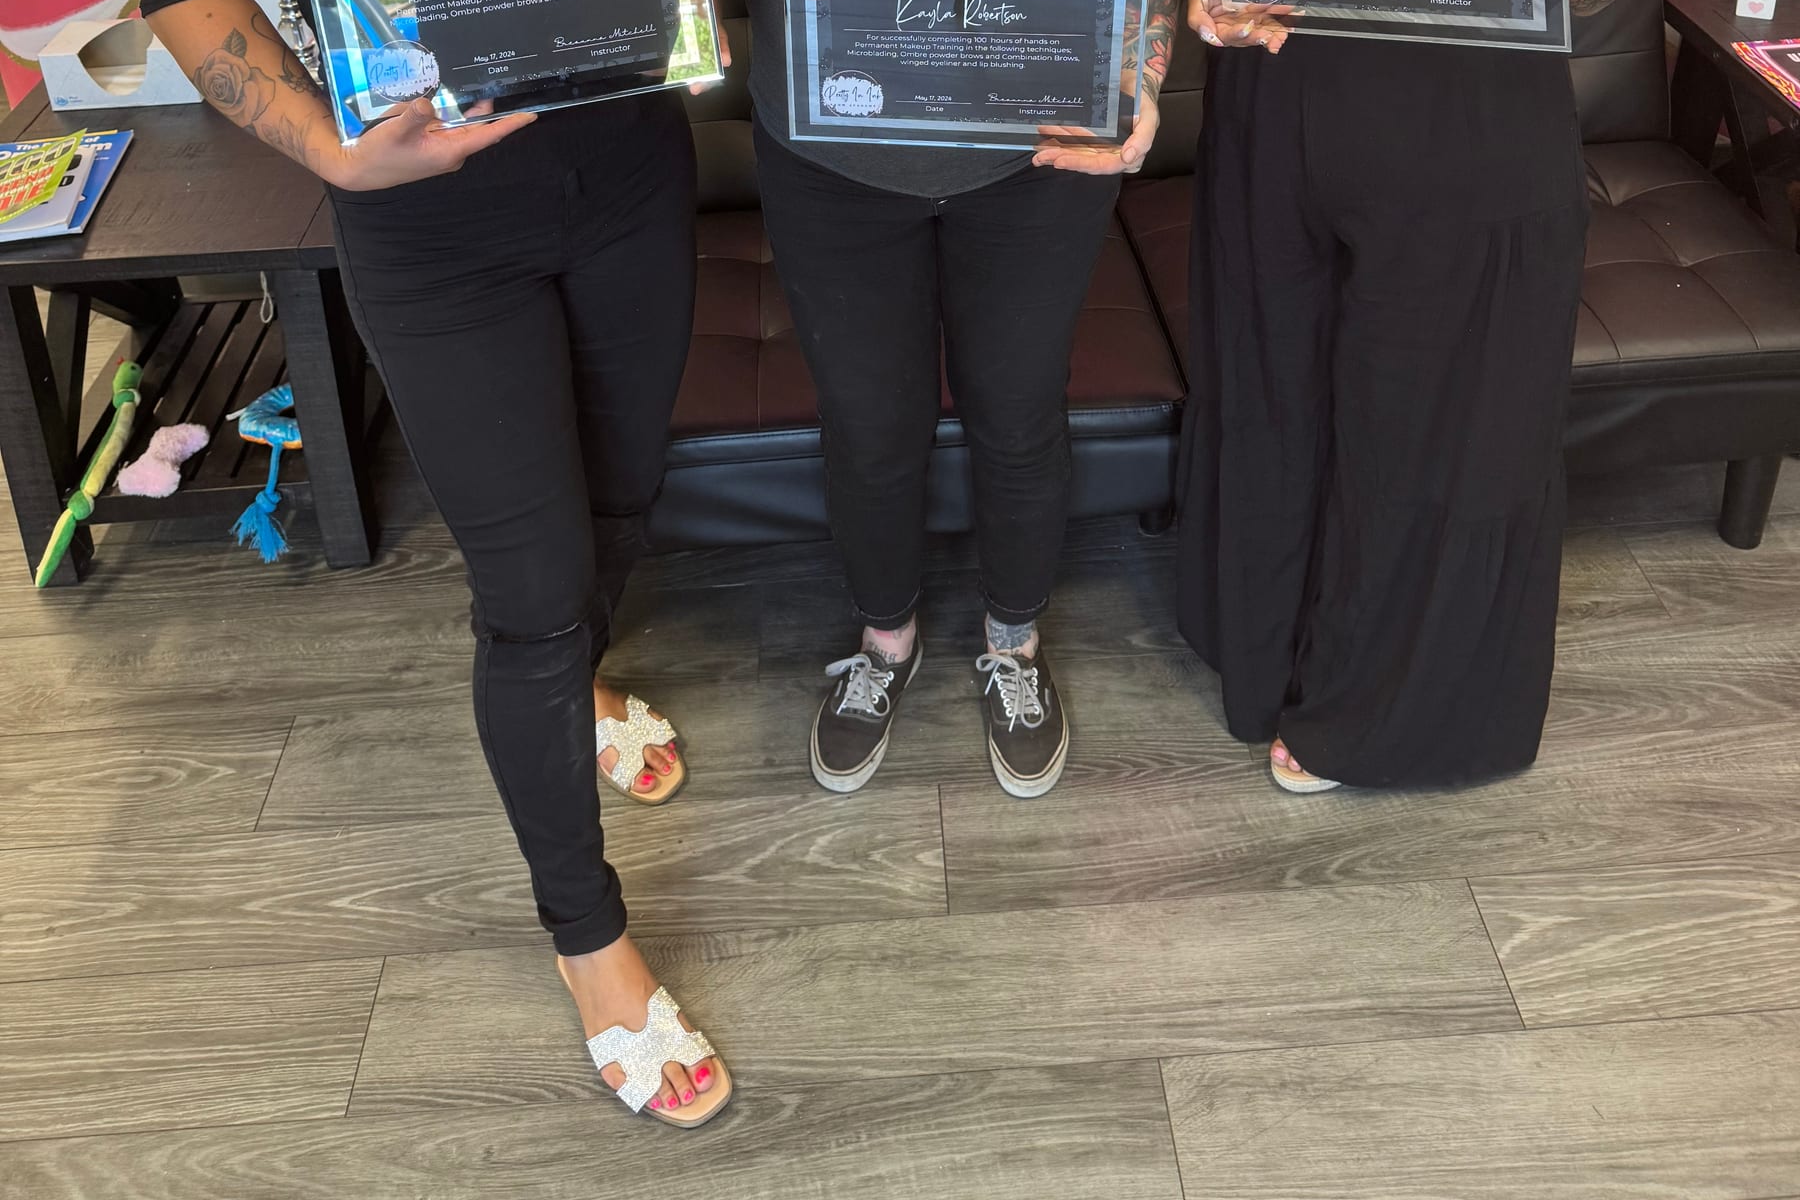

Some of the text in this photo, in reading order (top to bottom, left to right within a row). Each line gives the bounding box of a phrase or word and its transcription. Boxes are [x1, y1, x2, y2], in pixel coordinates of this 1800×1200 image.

[450, 8, 480, 18] Ombre
[482, 1, 515, 13] powder
[608, 24, 656, 39] Mitchell
[880, 35, 926, 43] successfully
[927, 36, 972, 44] completing
[590, 44, 630, 57] Instructor
[847, 50, 899, 58] Microblading,
[855, 41, 898, 49] Permanent
[989, 45, 1025, 53] following
[1027, 46, 1072, 54] techniques;
[473, 55, 488, 64] May
[499, 50, 516, 59] 2024
[487, 65, 509, 75] Date
